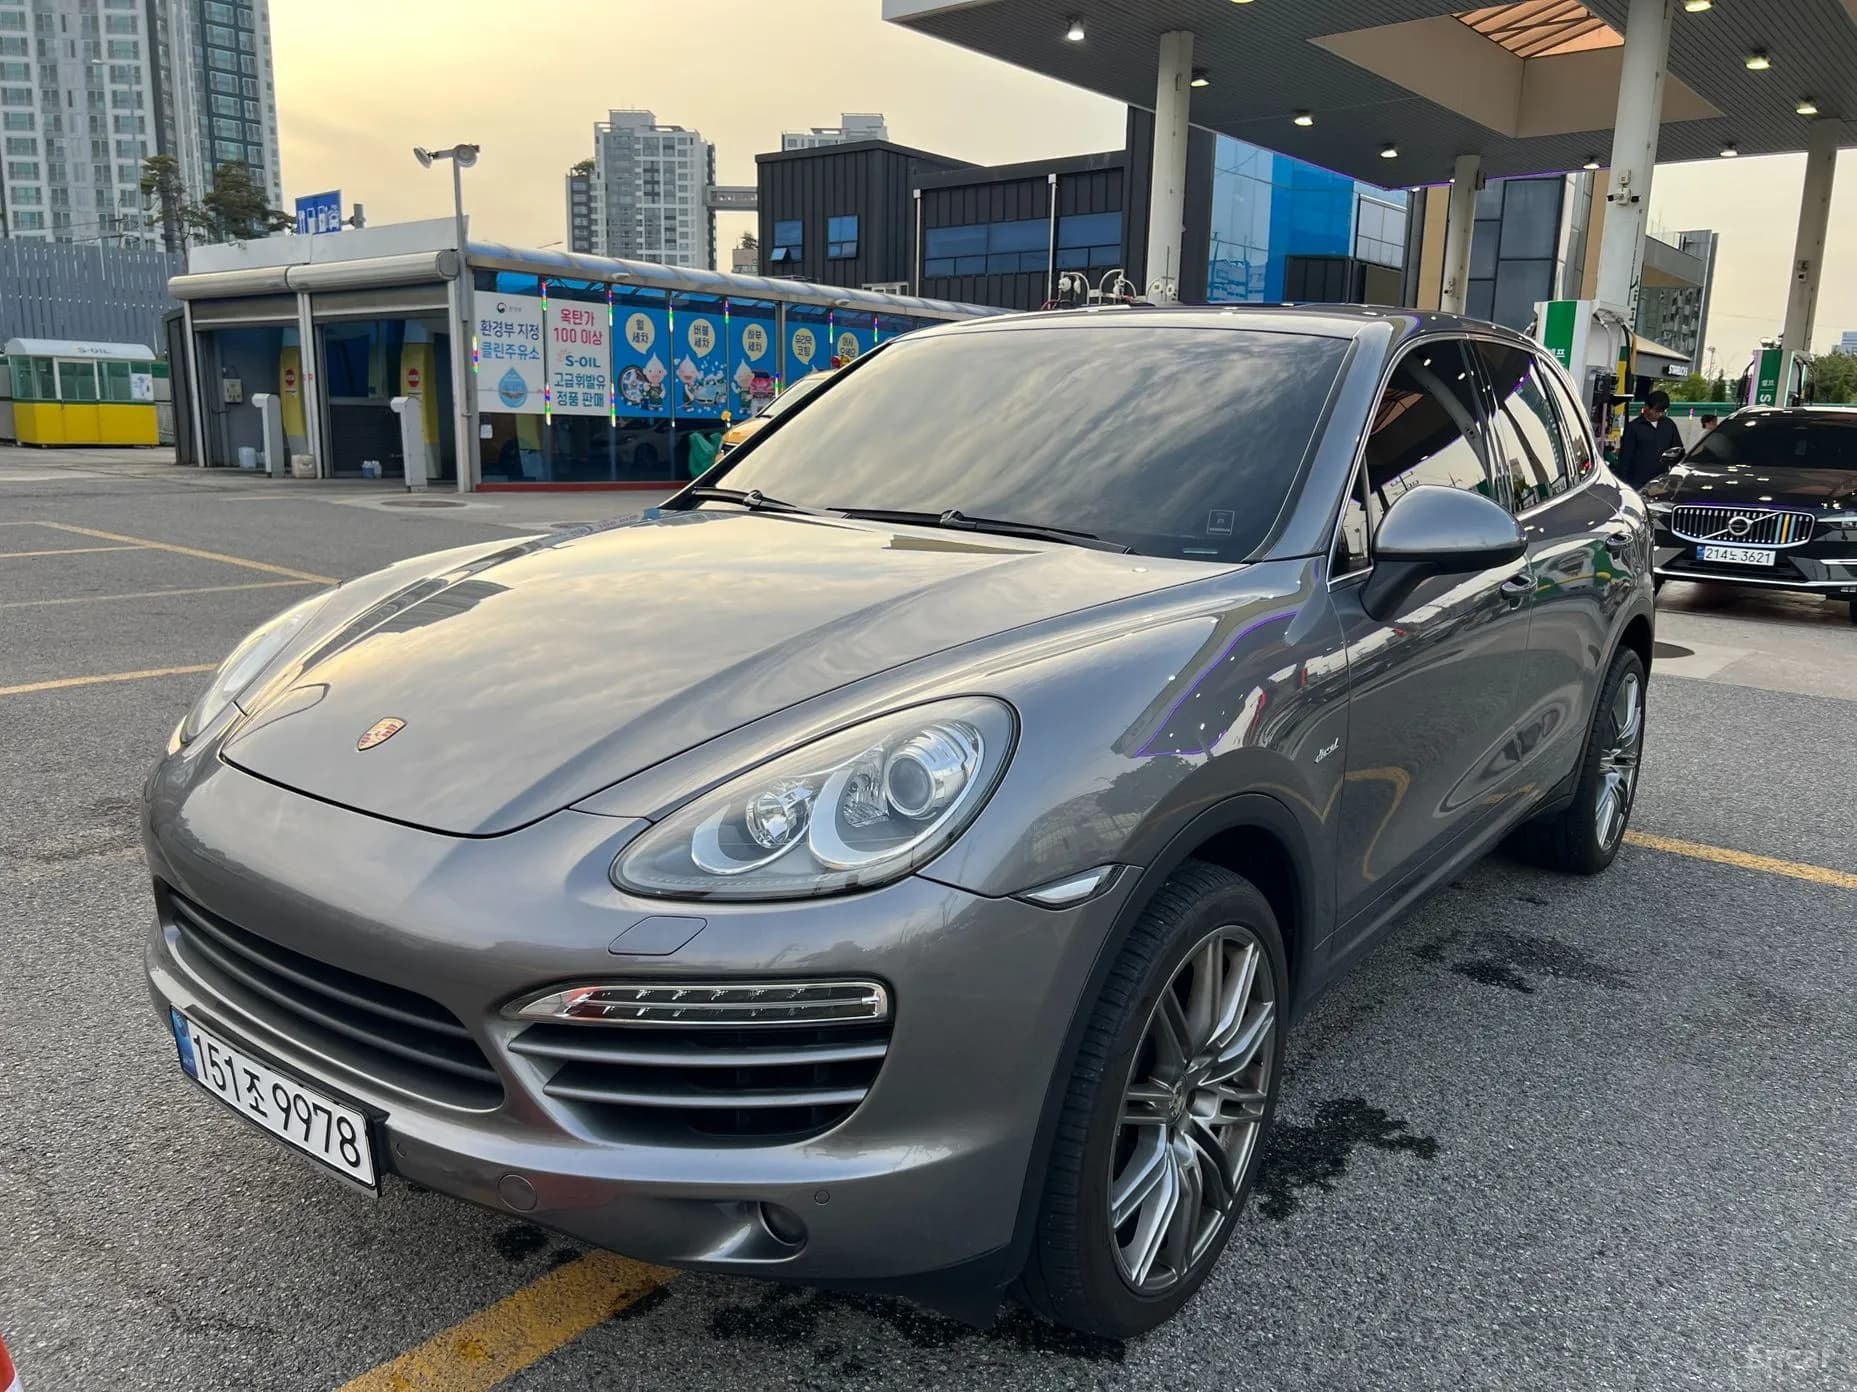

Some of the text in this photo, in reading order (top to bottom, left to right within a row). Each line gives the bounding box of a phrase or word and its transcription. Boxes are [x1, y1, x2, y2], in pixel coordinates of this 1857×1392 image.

[560, 308, 595, 326] 옥탄가
[480, 320, 540, 341] 환경부 지정
[553, 327, 603, 345] 100 이상
[481, 341, 540, 360] 클린주유소
[565, 355, 601, 368] S-OIL
[554, 372, 606, 389] 고급휘발유
[556, 391, 604, 408] 정품 판매
